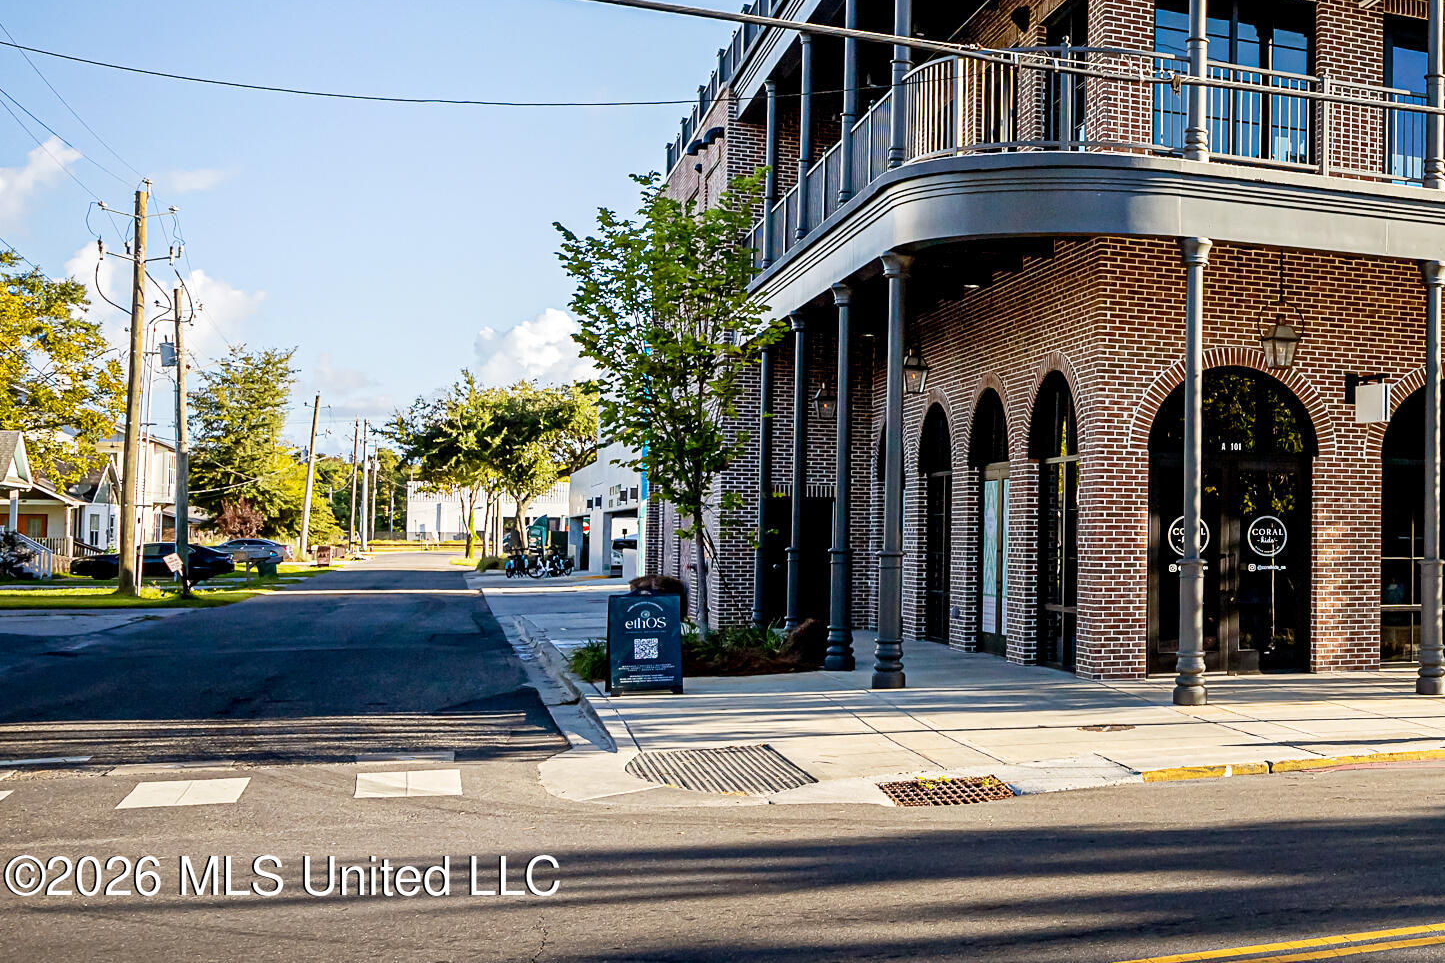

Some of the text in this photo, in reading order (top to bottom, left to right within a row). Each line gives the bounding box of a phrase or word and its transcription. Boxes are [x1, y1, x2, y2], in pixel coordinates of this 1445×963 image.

[1221, 442, 1242, 451] A 101
[1172, 527, 1206, 536] COL
[1252, 528, 1283, 536] CORAL
[625, 616, 667, 630] ethOS
